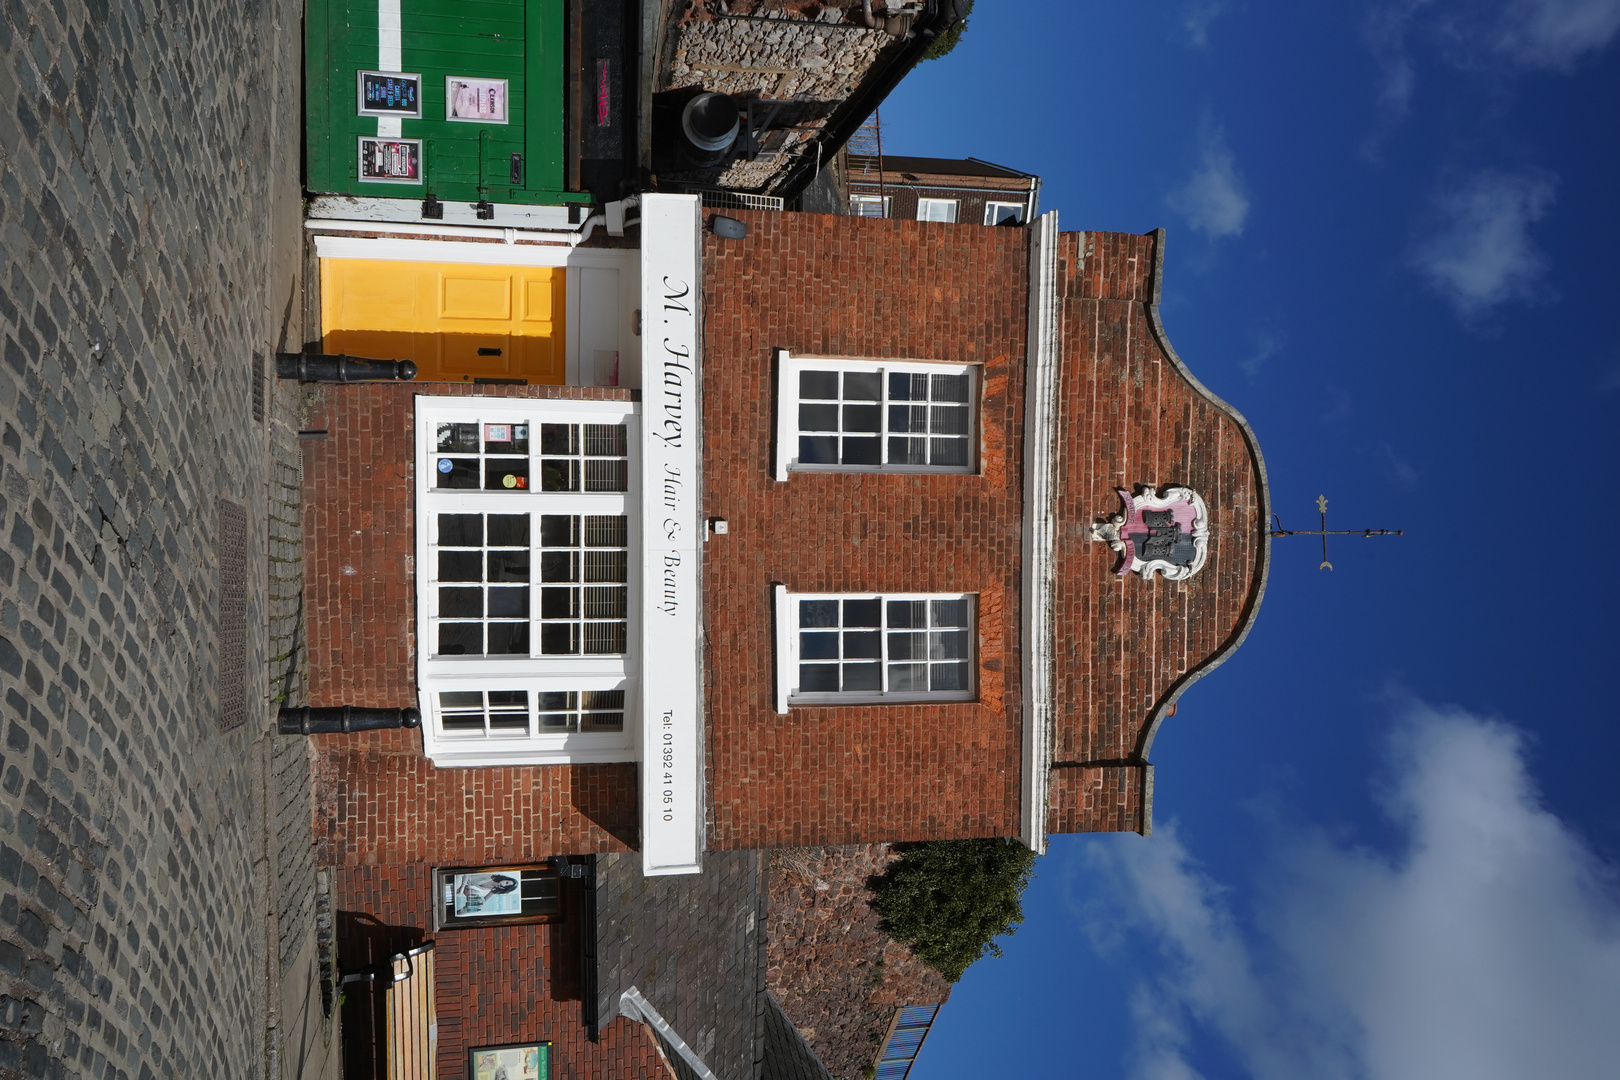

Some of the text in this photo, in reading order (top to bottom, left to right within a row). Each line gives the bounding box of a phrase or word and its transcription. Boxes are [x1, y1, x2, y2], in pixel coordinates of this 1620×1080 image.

[663, 462, 683, 511] Hair
[663, 518, 681, 543] &
[656, 549, 681, 617] Beauty
[662, 710, 673, 823] Tel: 01392 41 05 10
